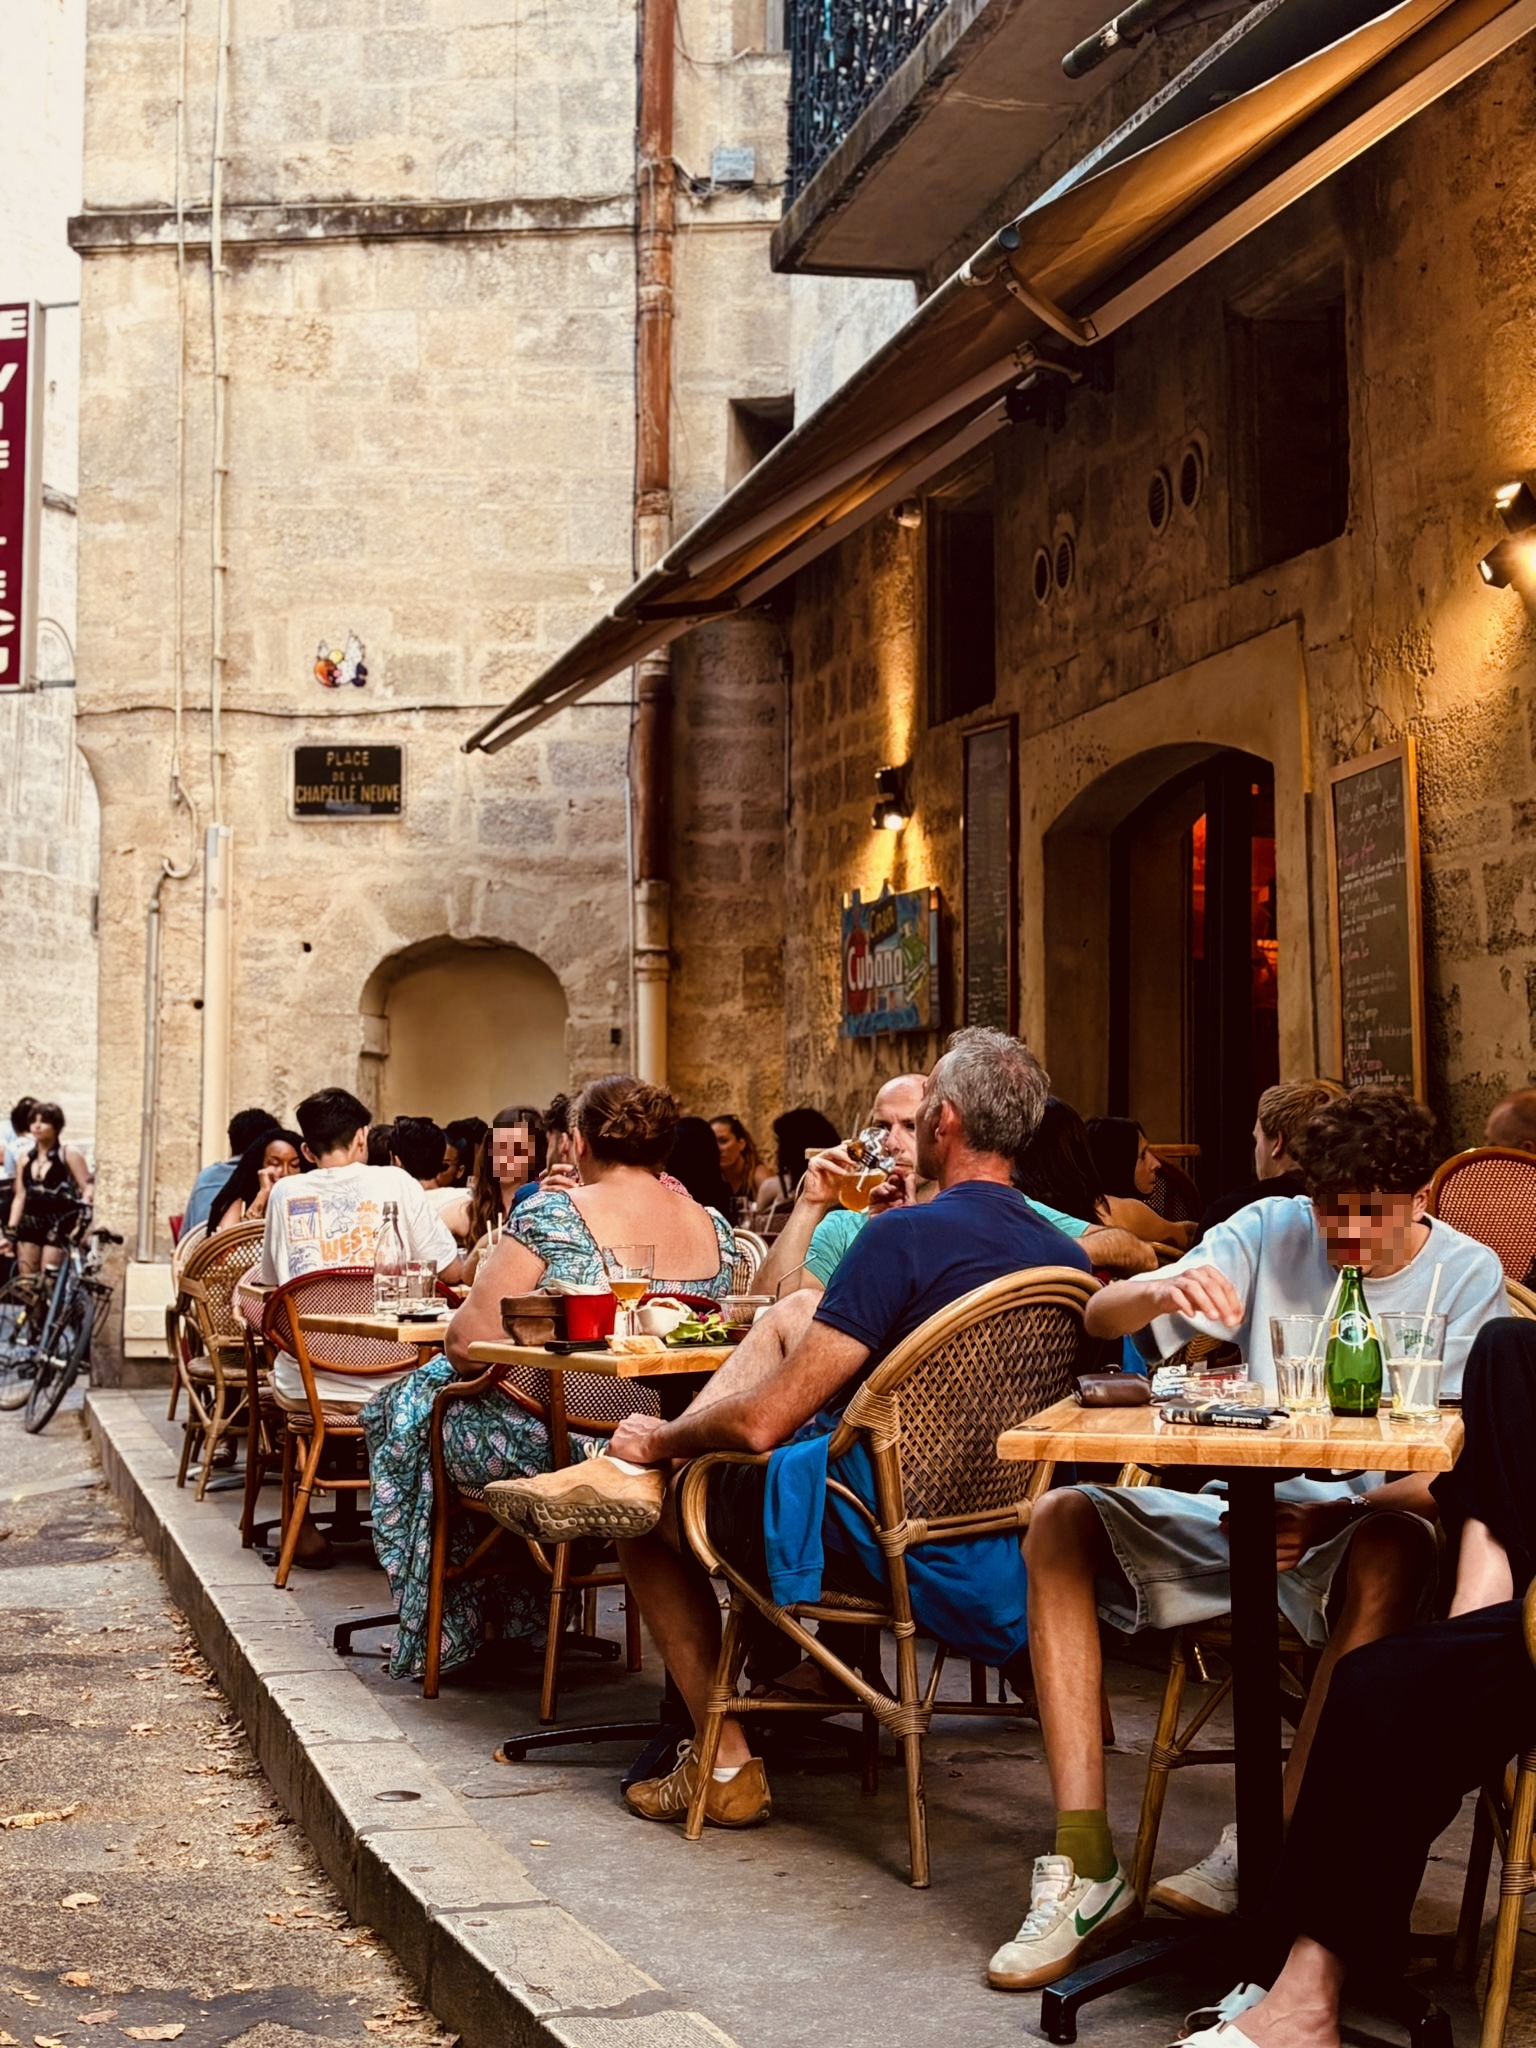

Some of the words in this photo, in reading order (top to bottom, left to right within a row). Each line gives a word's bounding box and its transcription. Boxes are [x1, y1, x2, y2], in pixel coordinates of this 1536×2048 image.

[327, 751, 369, 766] PLACE
[351, 771, 364, 782] LA
[295, 785, 356, 804] CHAPELLE
[361, 784, 400, 803] NEUVE
[848, 943, 904, 992] Cubana
